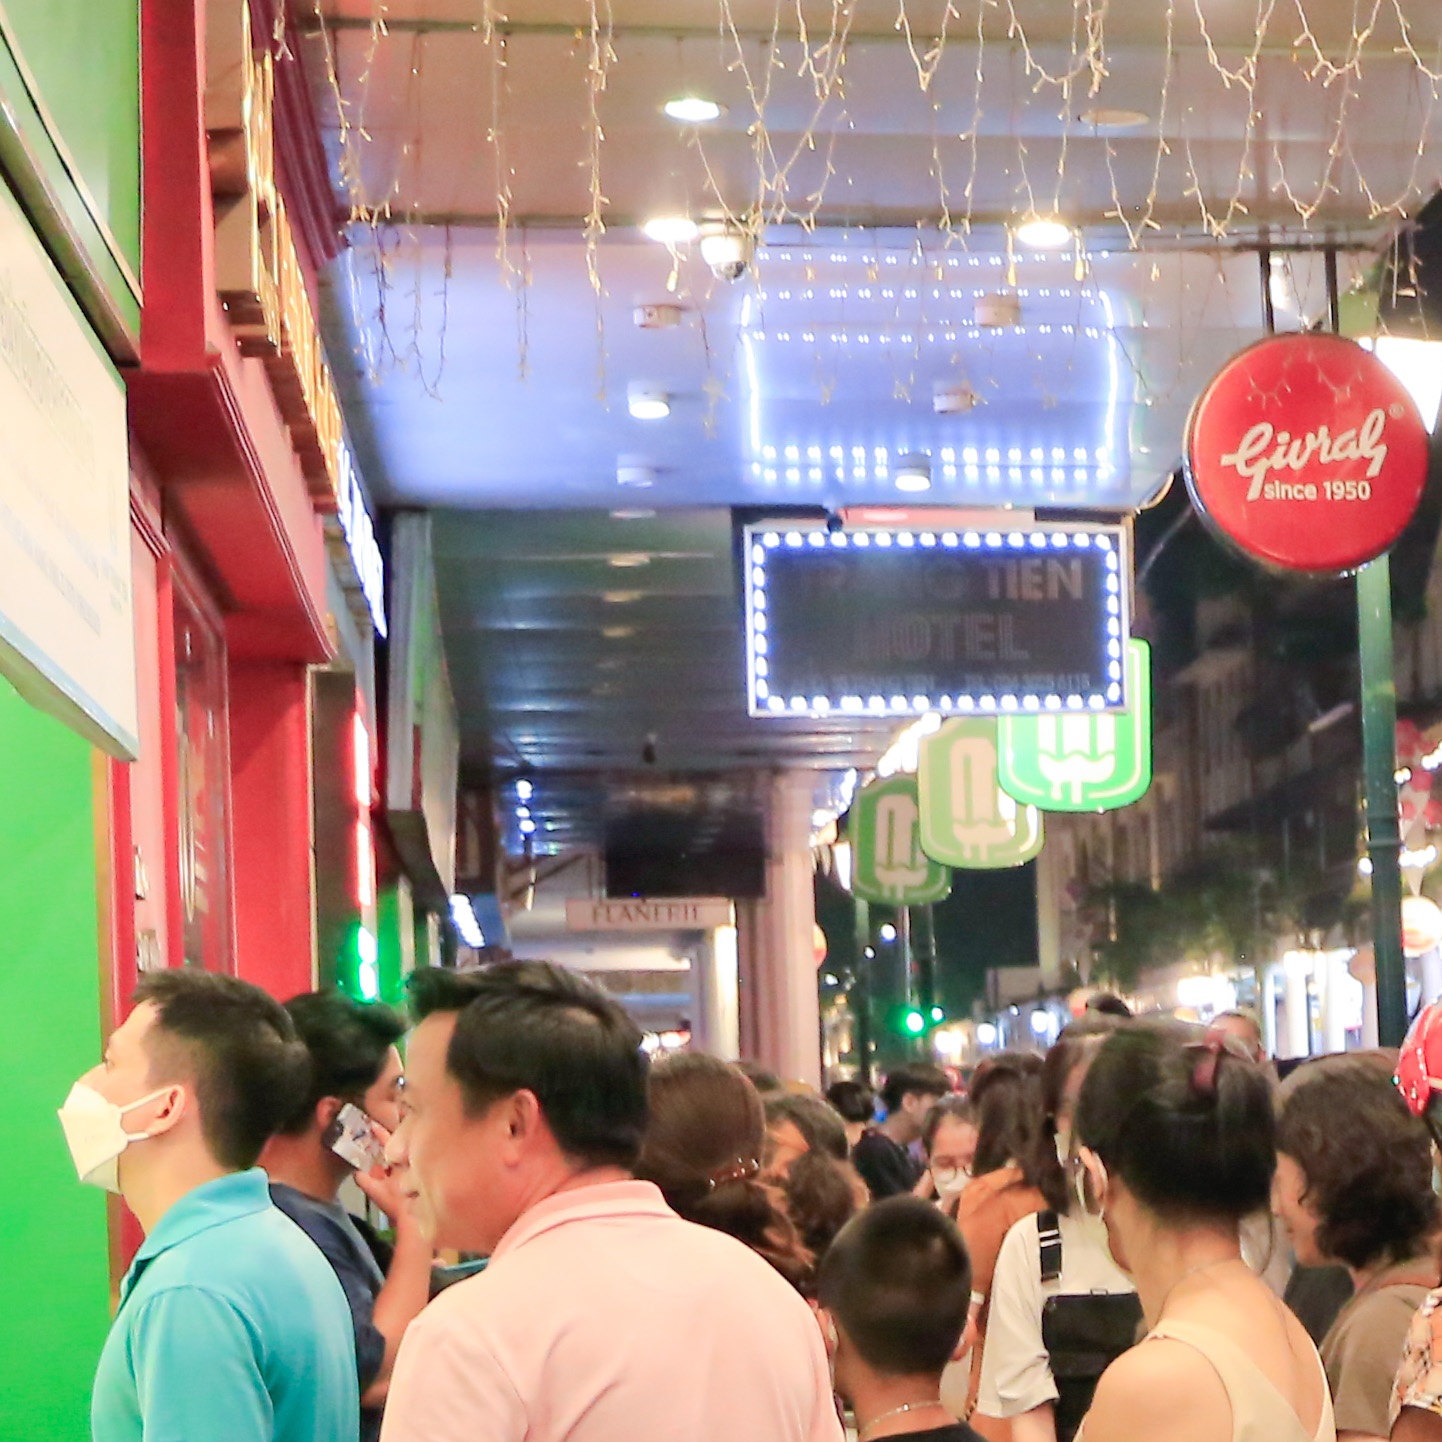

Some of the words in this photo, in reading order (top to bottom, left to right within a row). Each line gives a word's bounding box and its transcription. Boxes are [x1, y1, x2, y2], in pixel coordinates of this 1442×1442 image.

[1220, 408, 1388, 500] Givral
[1263, 480, 1317, 500] since
[1322, 480, 1371, 501] 1950
[984, 557, 1083, 600] TIEN
[853, 612, 1030, 661] HOTEL
